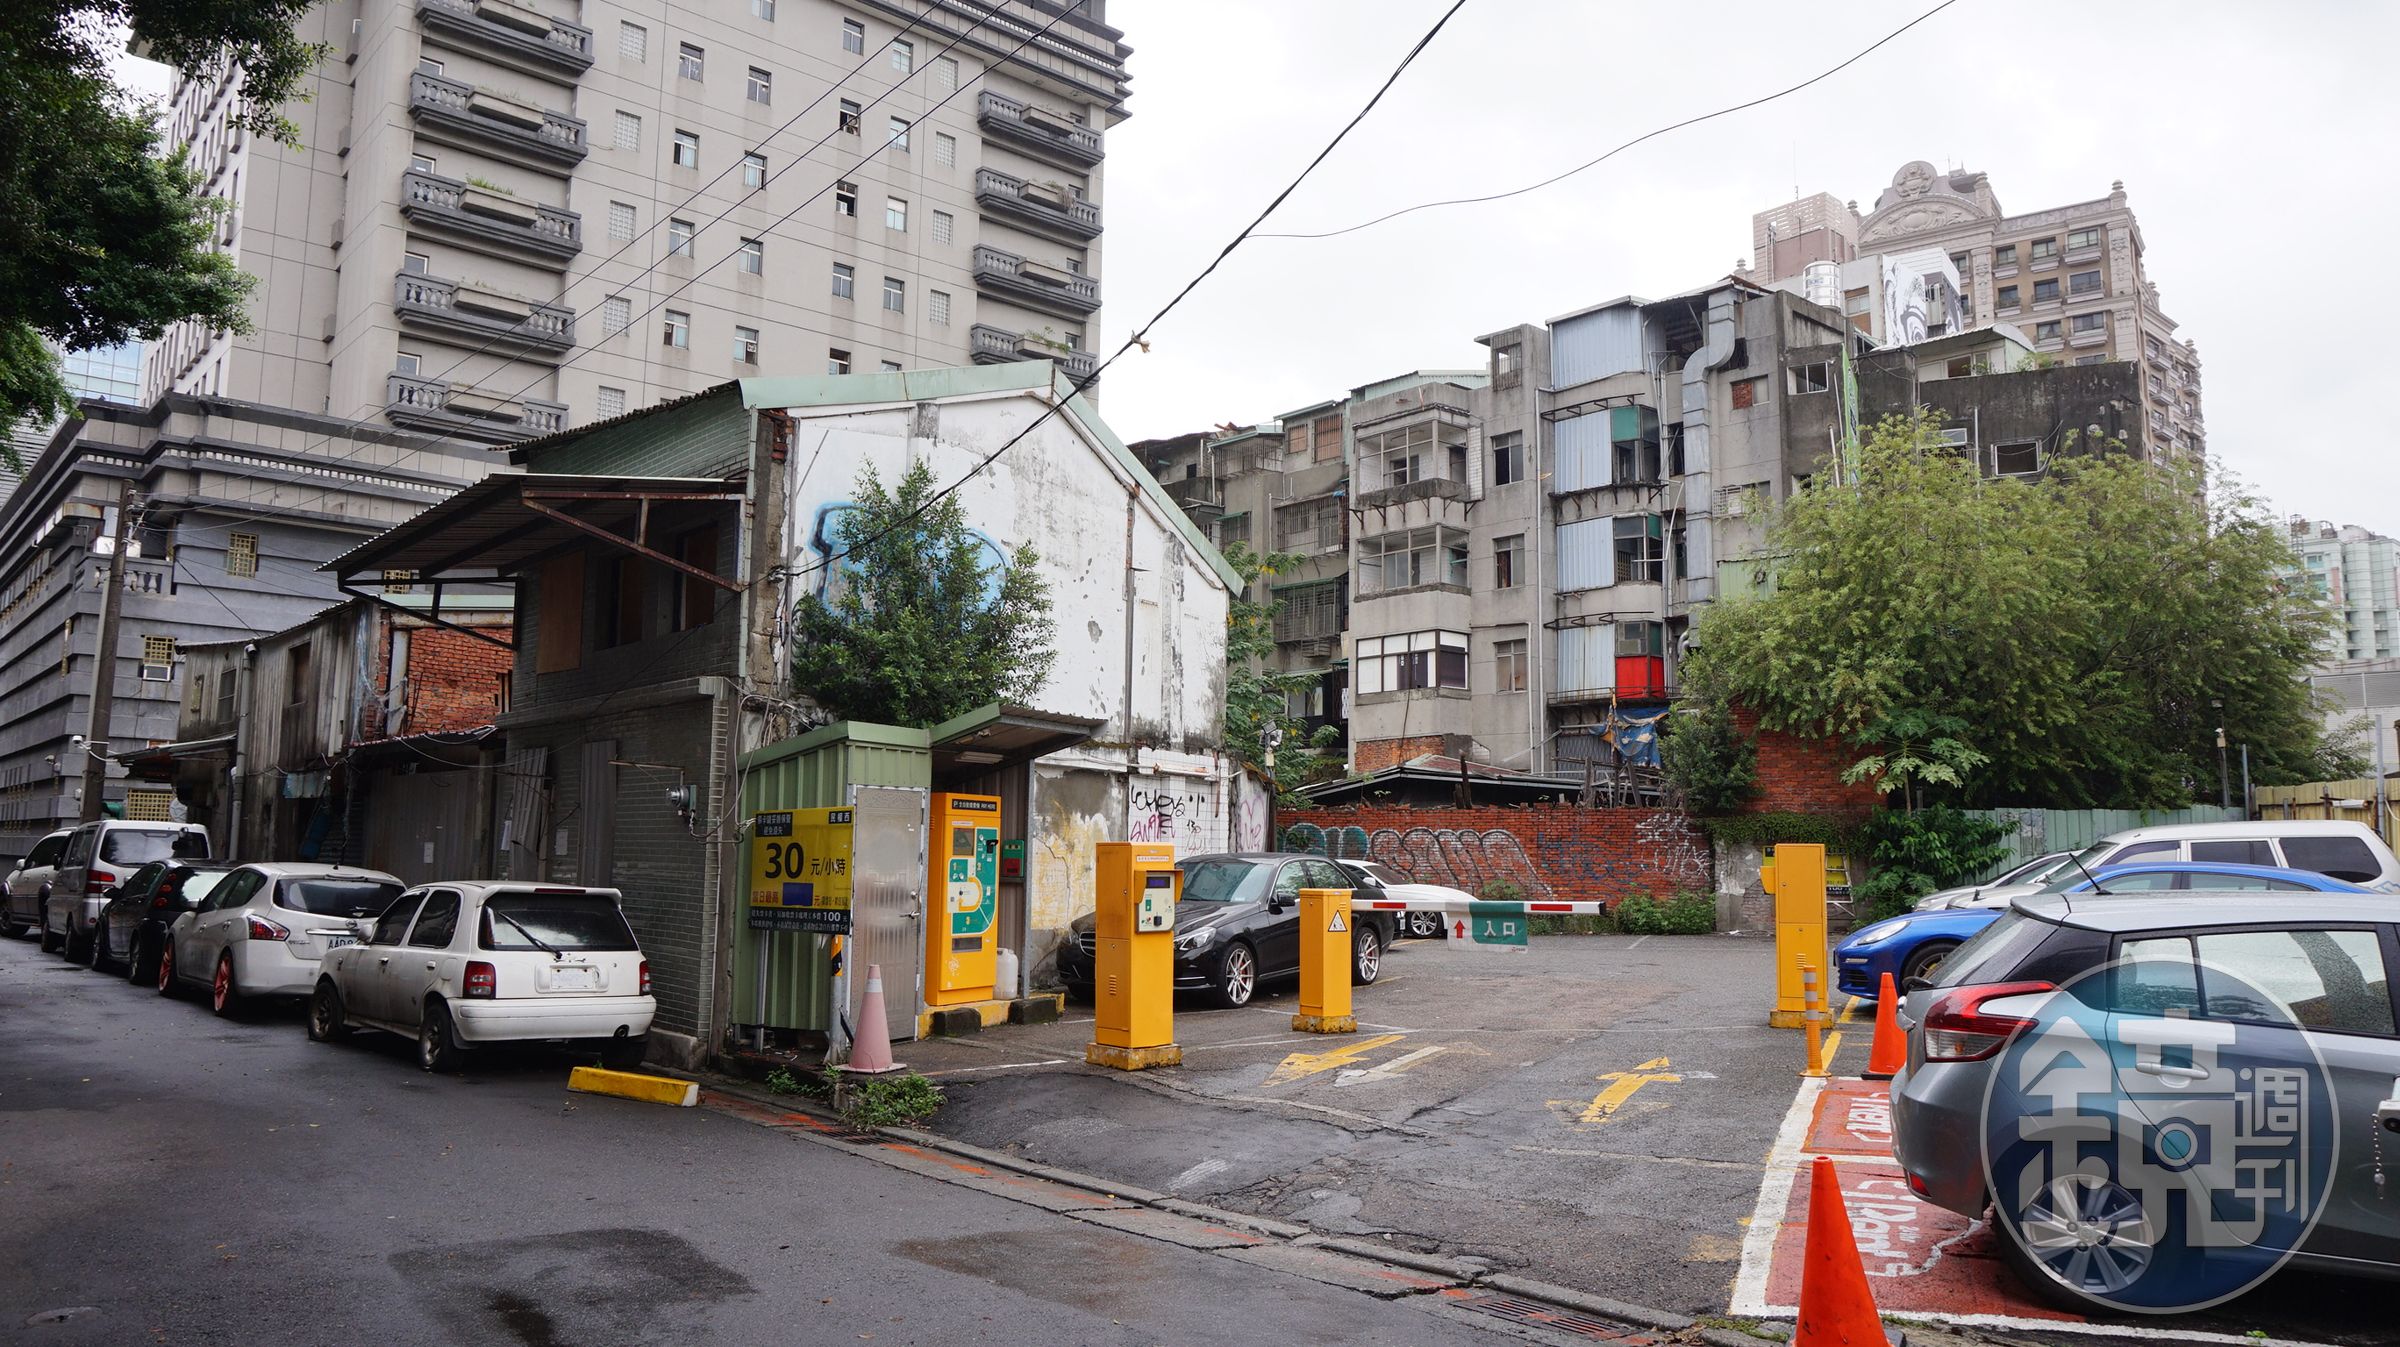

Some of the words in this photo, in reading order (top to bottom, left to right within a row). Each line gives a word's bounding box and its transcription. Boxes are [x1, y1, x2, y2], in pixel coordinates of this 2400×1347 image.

[765, 842, 804, 879] 30
[810, 857, 846, 876] 元/小時
[823, 912, 841, 922] 100
[1484, 920, 1516, 936] 入口
